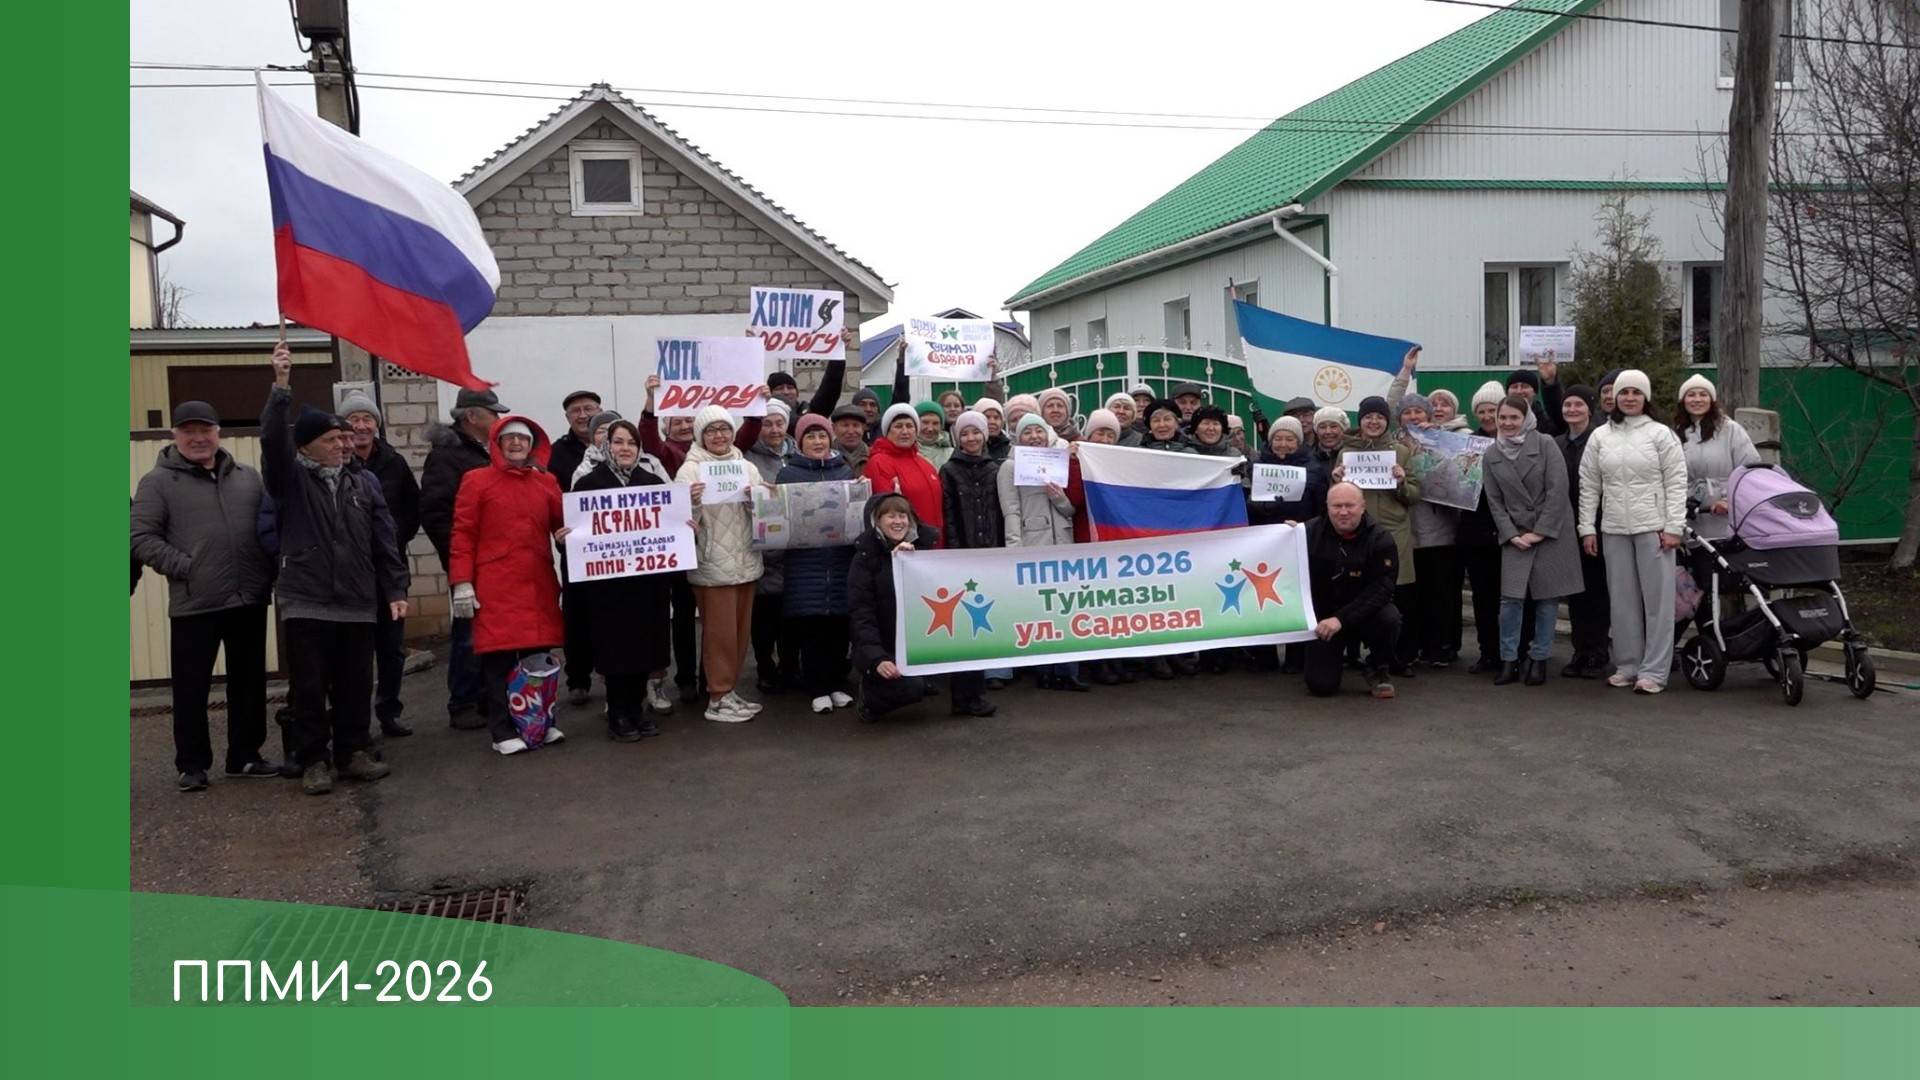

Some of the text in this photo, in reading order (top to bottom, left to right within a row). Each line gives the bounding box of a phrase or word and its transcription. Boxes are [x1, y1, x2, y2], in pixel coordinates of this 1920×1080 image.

[752, 291, 814, 328] ХОТИМ
[1351, 465, 1388, 473] НУЖЕН
[1357, 454, 1380, 462] НАМ
[717, 481, 738, 492] 2026
[1266, 482, 1290, 493] 2026
[1352, 477, 1393, 485] СФАЛЬТ
[580, 490, 671, 512] НАМ НУЖЕН
[592, 507, 661, 535] АСФАЛЬТ
[1016, 551, 1192, 585] ППМИ 2026
[1038, 584, 1175, 615] Туймазы
[1016, 609, 1201, 646] ул. Садовая
